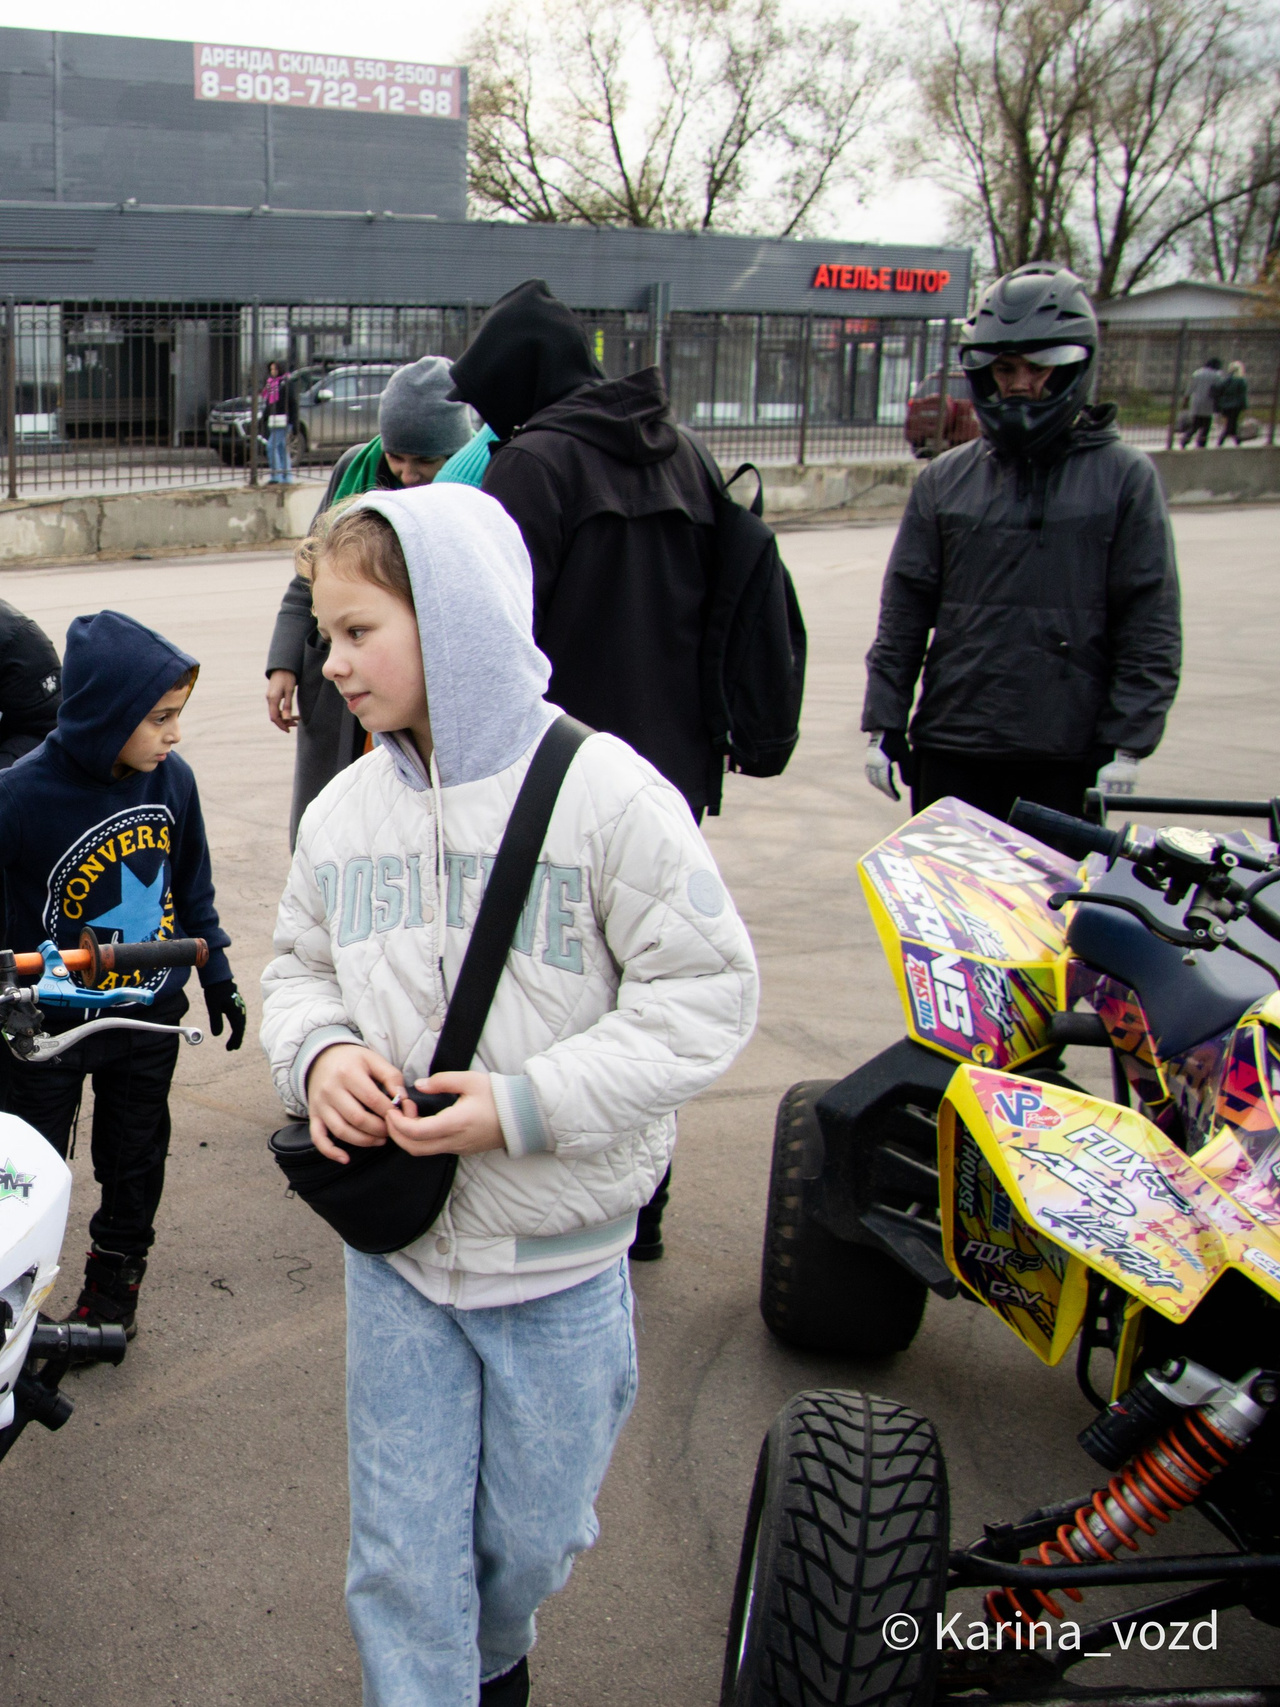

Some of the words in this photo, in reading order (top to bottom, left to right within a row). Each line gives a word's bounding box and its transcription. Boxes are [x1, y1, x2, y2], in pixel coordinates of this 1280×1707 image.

[200, 46, 274, 74] АРЕНДА
[278, 53, 350, 80] СКЛАДА
[353, 60, 437, 86] 550-2500
[201, 70, 452, 116] 8-903-722-12-98
[814, 263, 892, 290] АТЕЛЬЕ
[895, 268, 951, 293] ШТОР
[62, 825, 173, 920] CONVERS
[898, 825, 1050, 884] 228
[908, 956, 936, 1029] AMSOIL
[995, 1093, 1041, 1127] VP
[1063, 1124, 1157, 1182] FOX
[962, 1240, 1012, 1267] FOX
